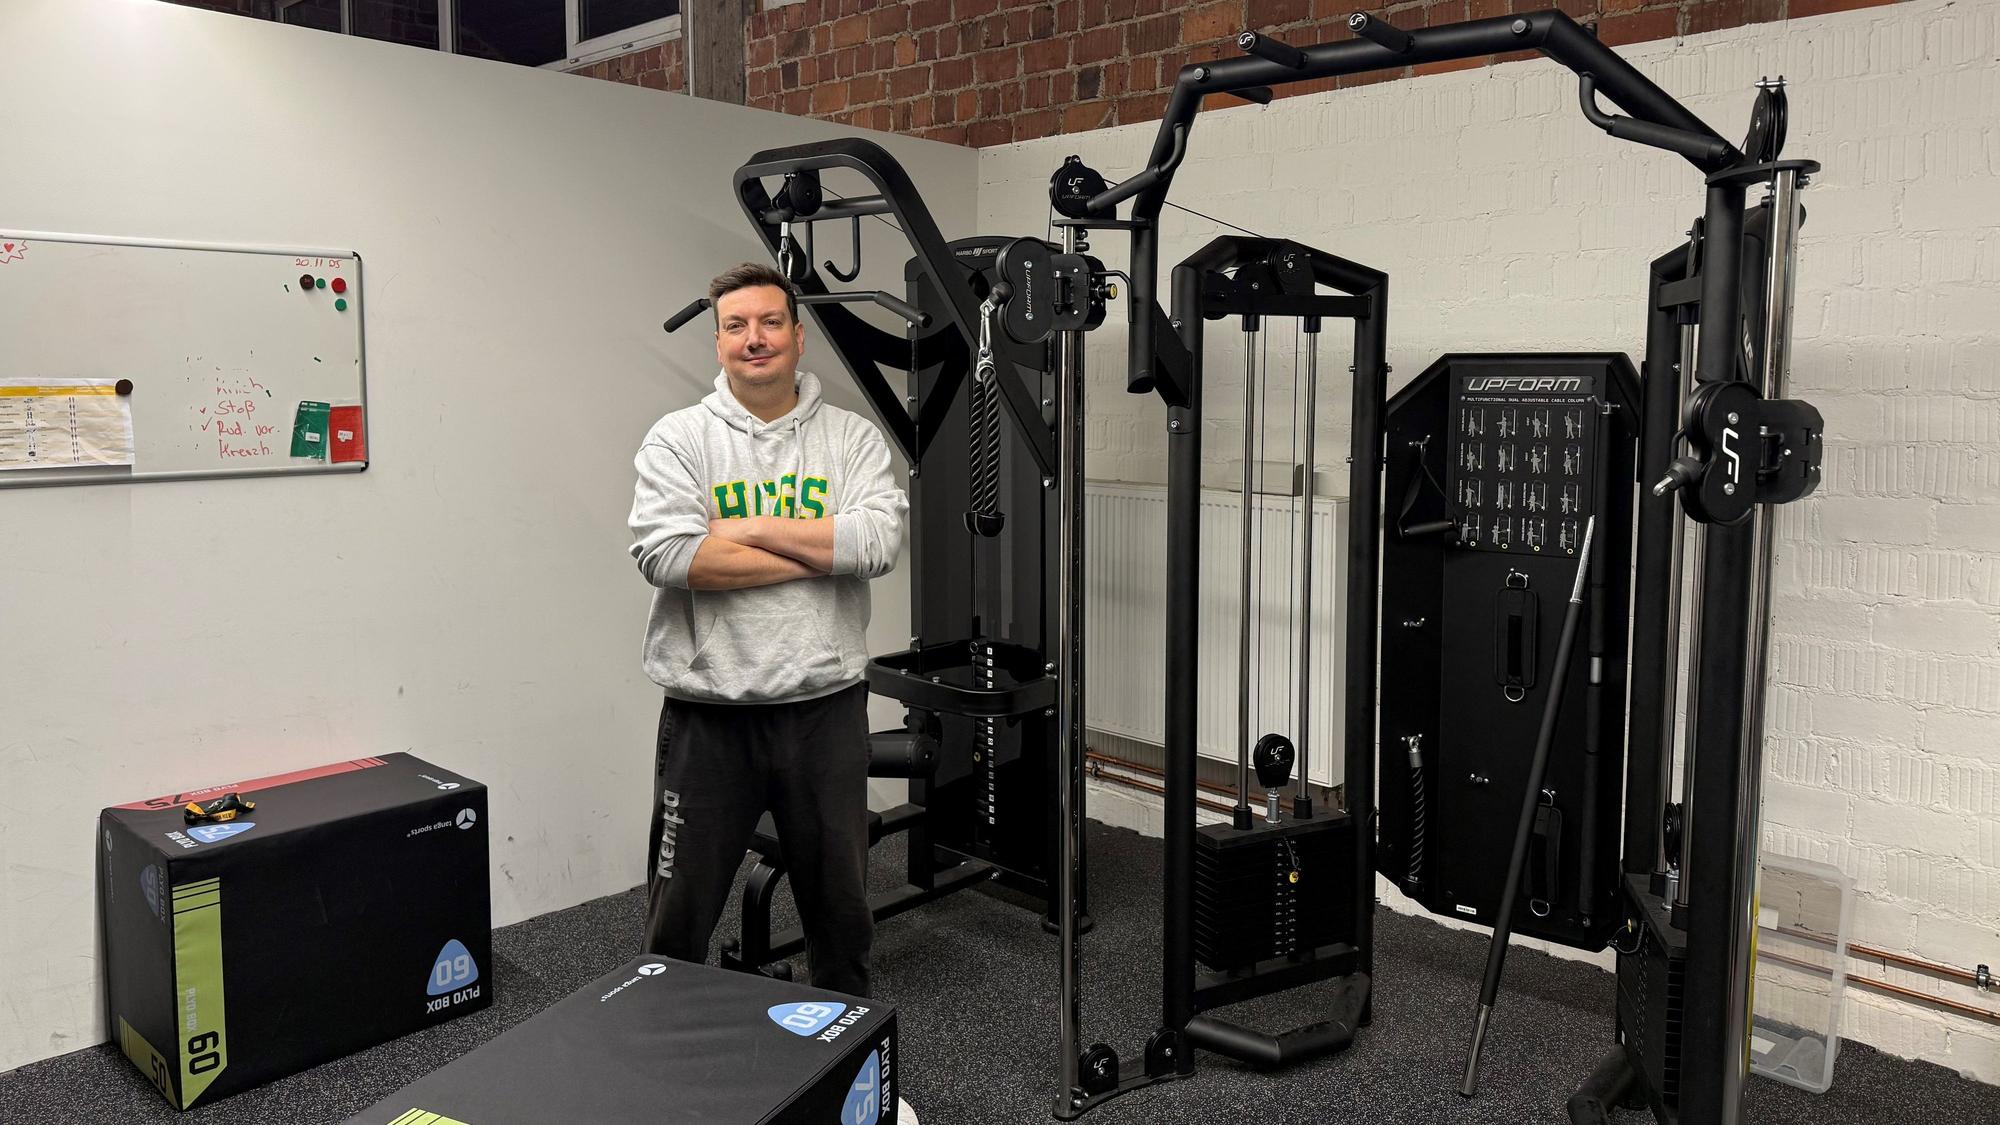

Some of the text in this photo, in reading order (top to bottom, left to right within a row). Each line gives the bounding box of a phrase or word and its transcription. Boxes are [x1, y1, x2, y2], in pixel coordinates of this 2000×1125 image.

[1467, 378, 1581, 391] UPFORM
[433, 820, 452, 830] tanga
[436, 954, 470, 987] 60
[426, 985, 480, 1014] PLYO BOX
[782, 1003, 833, 1029] 60
[816, 1005, 871, 1043] PLYO BOX
[188, 1030, 220, 1075] 60
[151, 1052, 167, 1093] 50
[880, 1036, 891, 1118] PLYO BOX
[855, 1066, 874, 1125] 75
